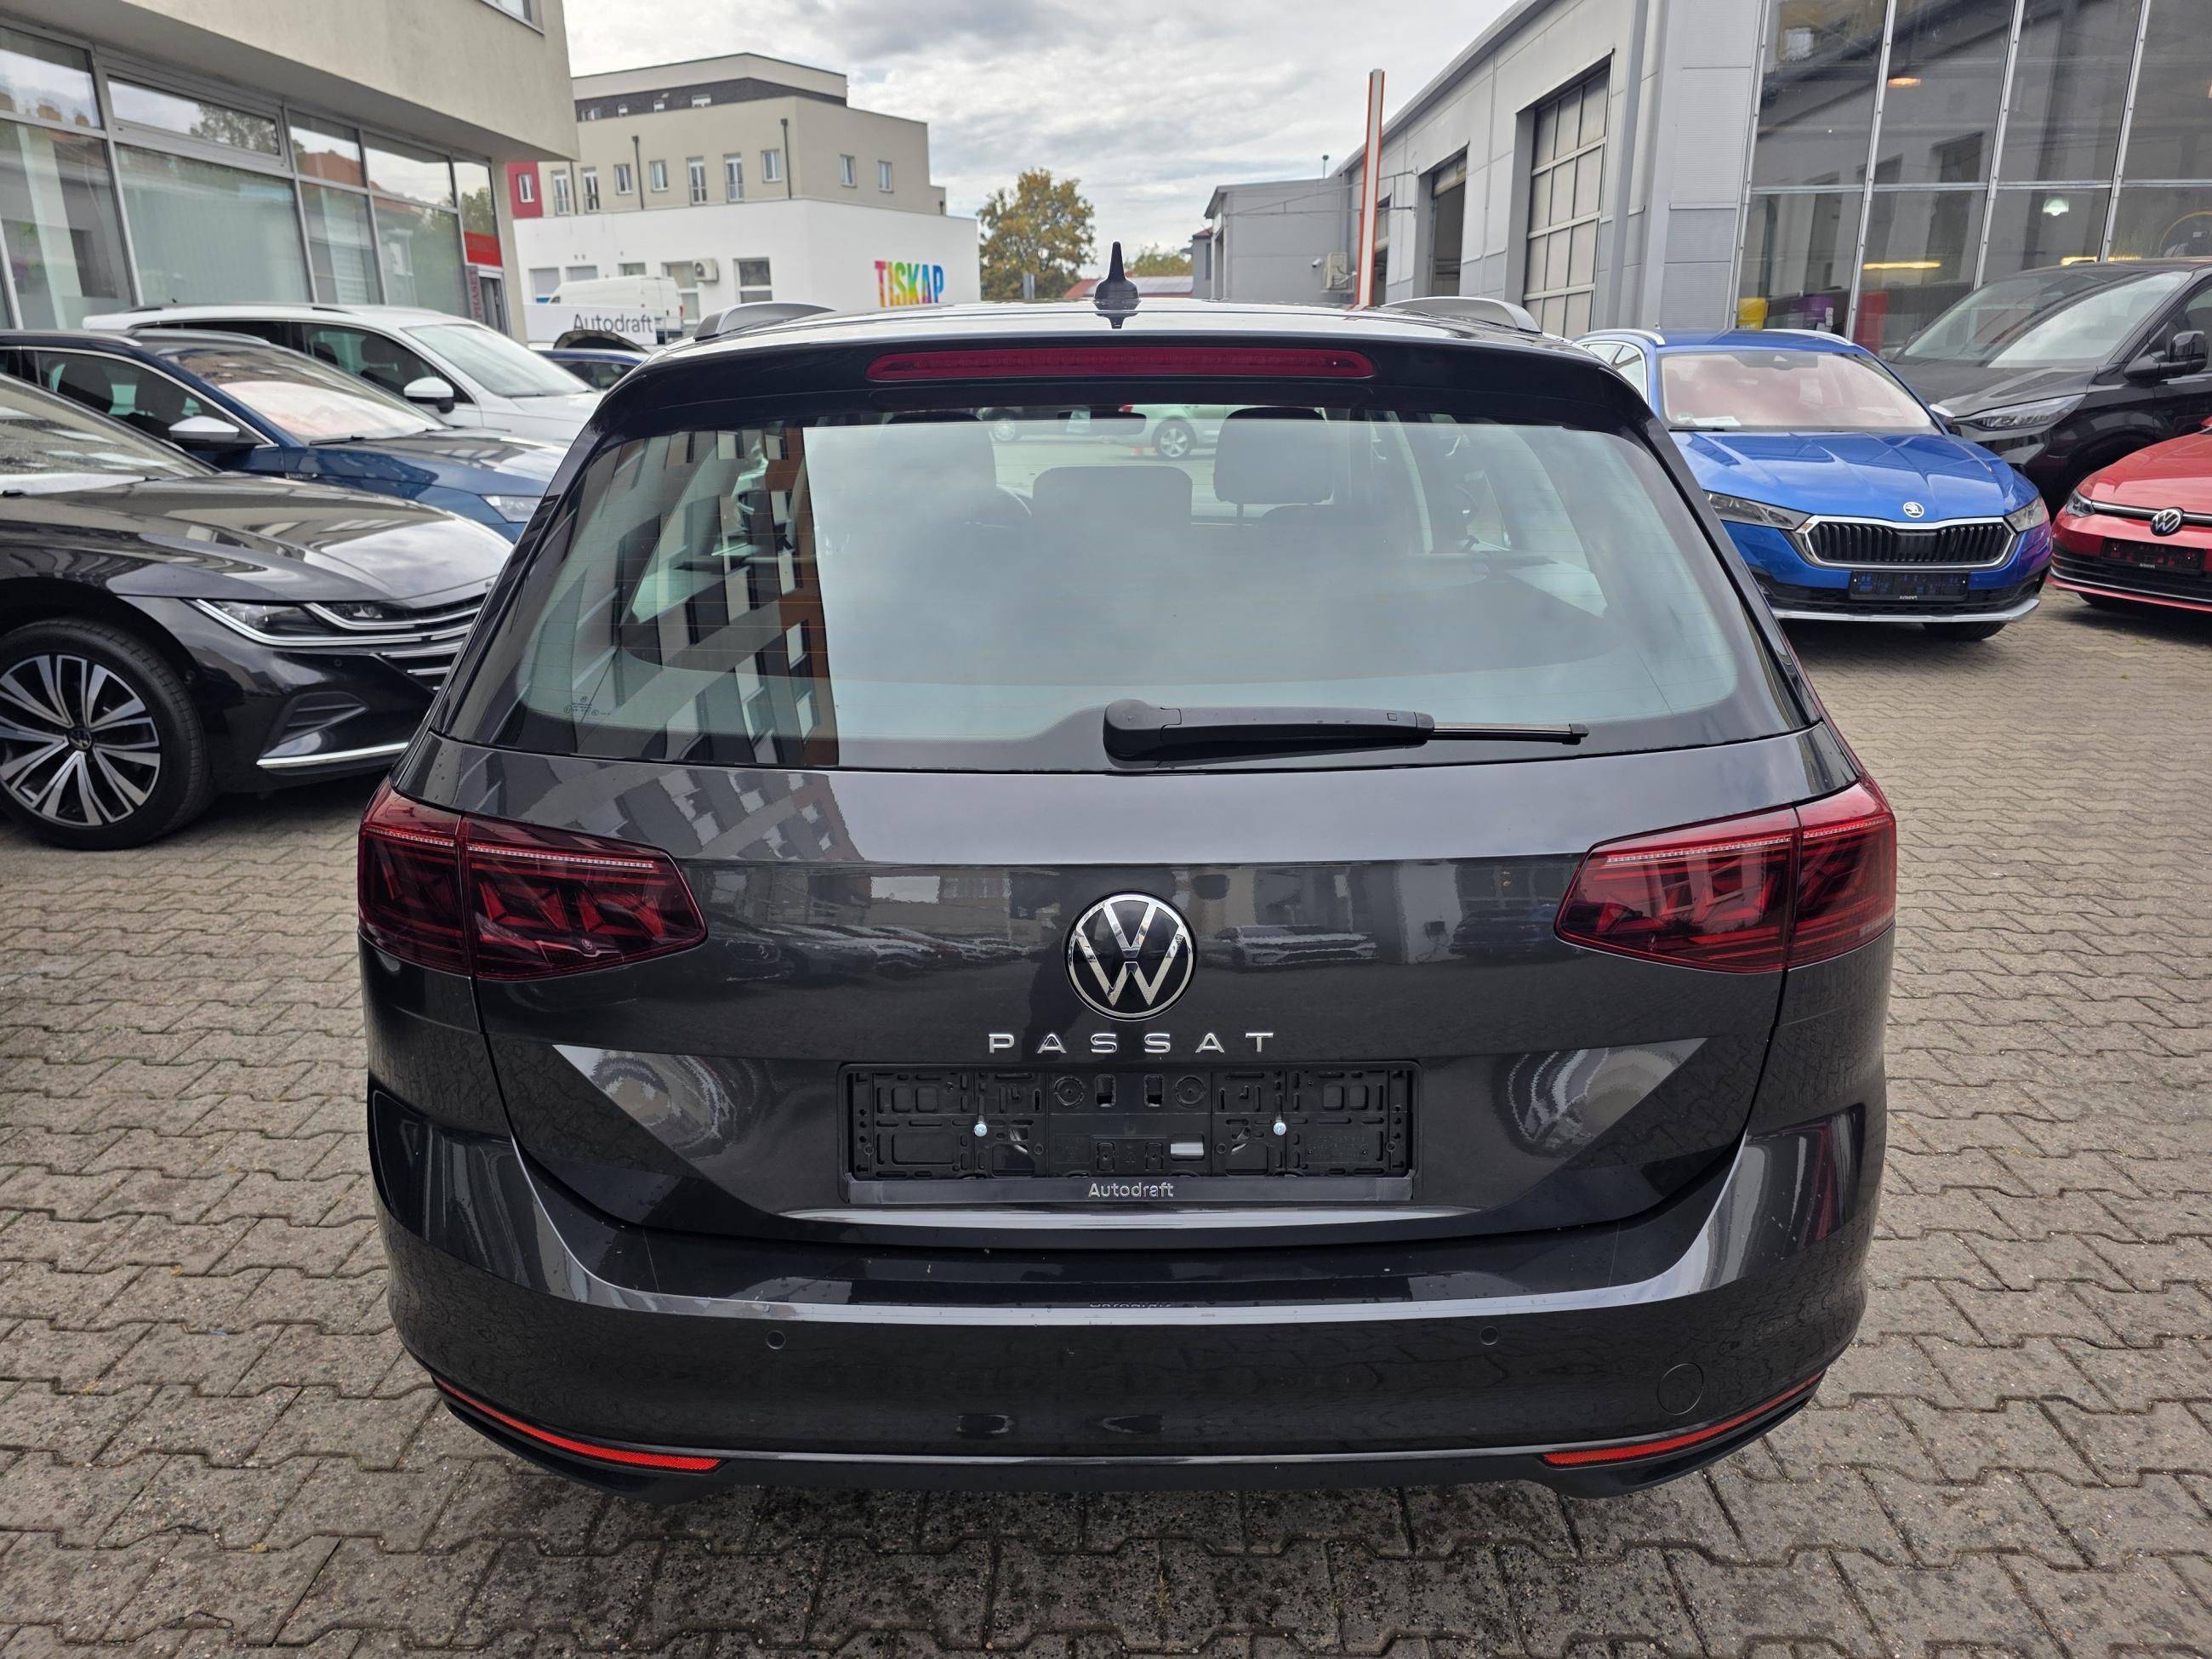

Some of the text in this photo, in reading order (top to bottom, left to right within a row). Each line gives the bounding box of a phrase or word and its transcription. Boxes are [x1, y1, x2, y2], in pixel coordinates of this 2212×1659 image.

[874, 259, 944, 307] TISKAP
[573, 313, 653, 334] Autodraft
[1069, 892, 1193, 1019] VW
[988, 1032, 1274, 1054] PASSAT
[1088, 1182, 1174, 1198] Autodraft
